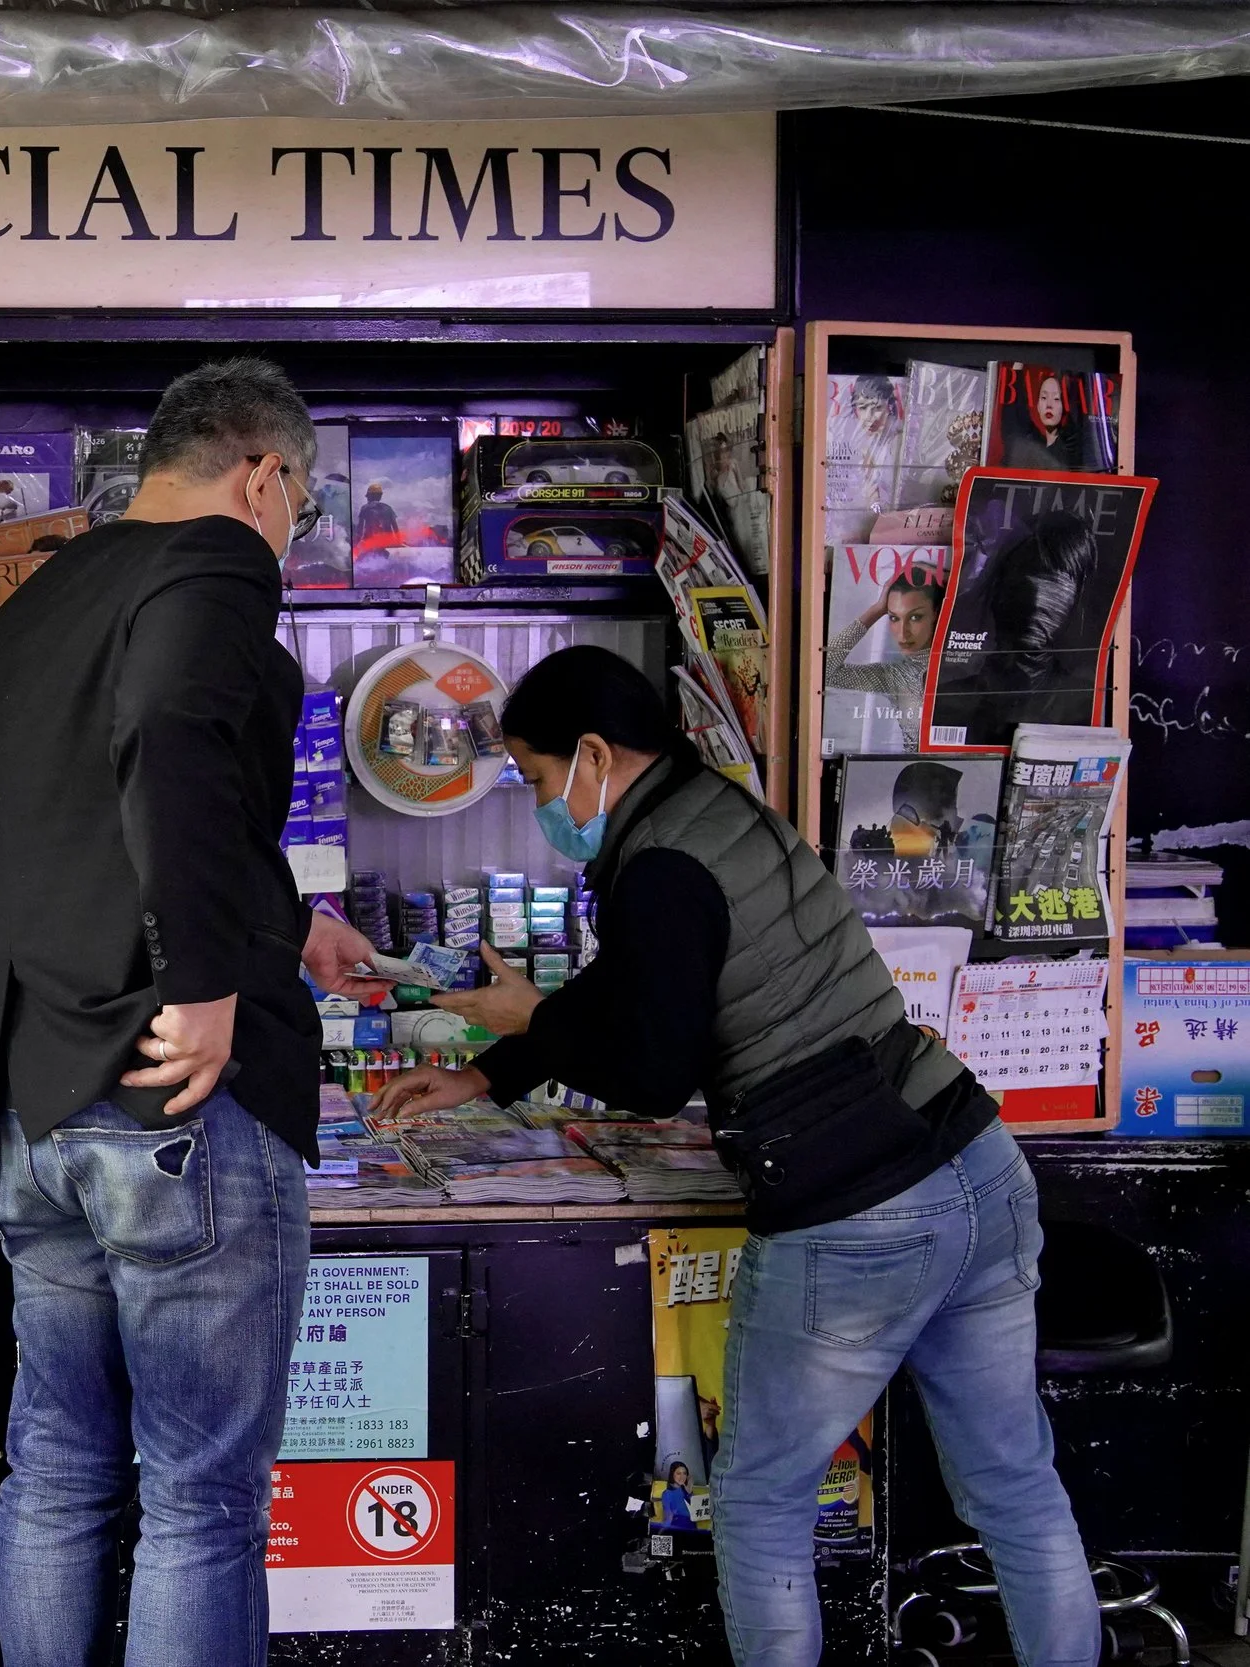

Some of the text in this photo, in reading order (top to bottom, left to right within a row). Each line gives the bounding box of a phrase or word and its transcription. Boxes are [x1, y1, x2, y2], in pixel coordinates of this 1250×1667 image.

[271, 147, 677, 242] TIMES
[525, 488, 571, 498] PORSCHE
[571, 488, 585, 498] 911
[993, 482, 1124, 537] TIME
[949, 631, 989, 641] Faces of
[947, 640, 983, 650] Protest
[853, 706, 870, 720] La
[876, 705, 904, 720] Vita
[312, 736, 336, 748] Tempo
[850, 858, 975, 891] 榮光歲月
[451, 933, 479, 946] Winston
[1028, 970, 1037, 983] 2
[1218, 984, 1226, 992] 72
[1229, 984, 1237, 992] 64
[1143, 1000, 1180, 1009] Yantai
[1183, 1000, 1217, 1009] China
[1221, 1000, 1231, 1009] of
[1003, 1012, 1009, 1020] 4
[1023, 1011, 1030, 1019] 5
[1041, 1028, 1051, 1036] 13
[1061, 1026, 1071, 1034] 14
[1081, 1025, 1090, 1033] 15
[1134, 1020, 1161, 1048] 品
[1183, 1017, 1239, 1041] 精选
[978, 1062, 1090, 1077] 24 25 26 27 28 29
[322, 1266, 409, 1277] GOVERNMENT:
[305, 1280, 419, 1291] CT SHALL BE SOLD
[308, 1293, 410, 1304] 18 OR GIVEN FOR
[308, 1307, 386, 1318] ANY PERSON
[290, 1360, 364, 1376] 煙草產品予
[288, 1378, 364, 1392] 下人士或派
[357, 1419, 409, 1430] 1833 183
[356, 1438, 415, 1449] 2961 8823
[372, 1484, 413, 1496] UNDER
[367, 1501, 419, 1538] 18
[266, 1535, 299, 1547] rettes
